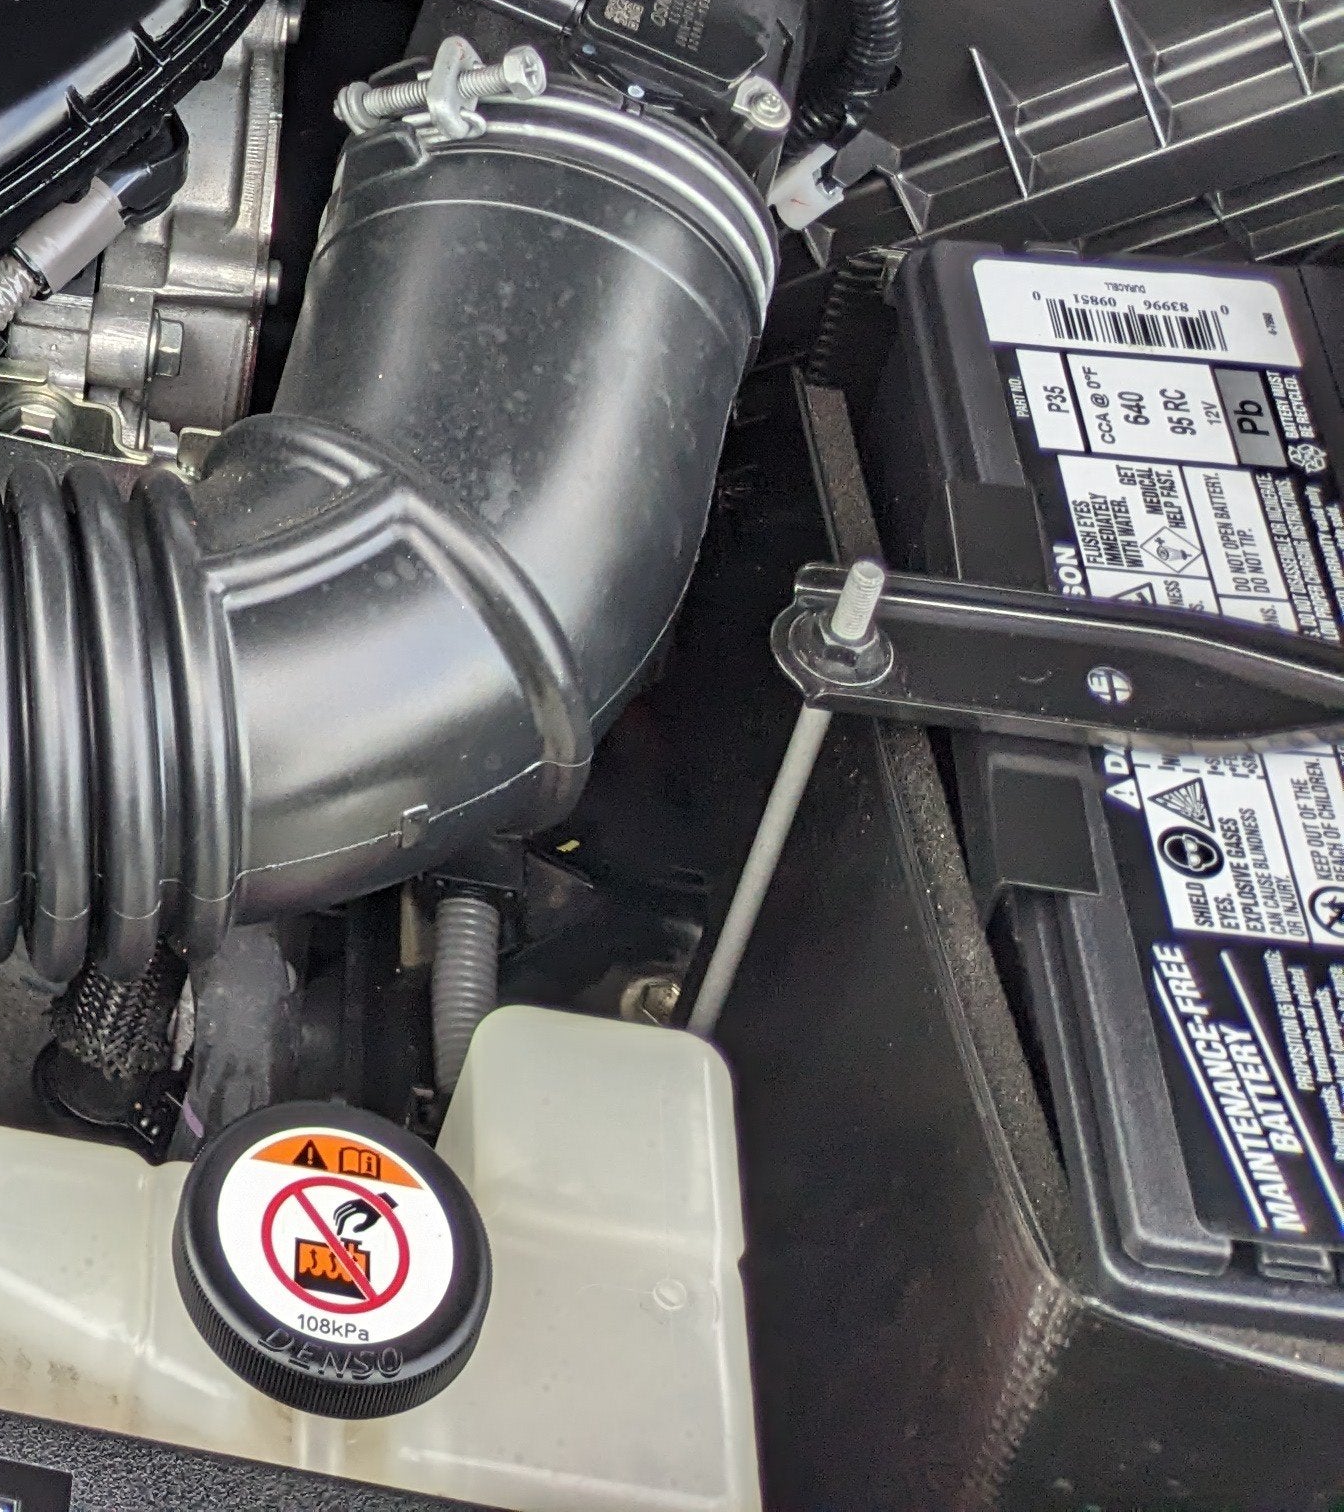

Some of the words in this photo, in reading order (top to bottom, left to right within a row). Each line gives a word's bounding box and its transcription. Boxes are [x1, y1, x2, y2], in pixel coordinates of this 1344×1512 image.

[1104, 282, 1146, 293] DURACELL
[1032, 291, 1041, 301] 0
[1072, 294, 1116, 307] 09851
[1143, 300, 1188, 312] 83996
[1220, 305, 1229, 315] 0
[1009, 376, 1022, 391] NO.
[1266, 370, 1284, 397] MUST
[1012, 394, 1029, 417] PART
[1043, 386, 1069, 413] P35
[1090, 393, 1109, 408] @
[1118, 391, 1150, 425] 640
[1159, 389, 1190, 412] RC
[1201, 401, 1221, 425] 12V
[1284, 375, 1310, 424] RECYCLED.
[1095, 413, 1116, 444] CCA
[1167, 416, 1196, 435] 95
[1234, 400, 1269, 436] Pb
[1275, 400, 1298, 438] BATTERY
[1300, 425, 1315, 438] BE
[1116, 464, 1137, 486] GET
[1155, 470, 1178, 499] FAST.
[1136, 467, 1164, 515] MEDICAL
[1203, 473, 1230, 519] BATTERY.
[1072, 500, 1094, 528] EYES
[1110, 497, 1135, 536] WATER.
[1163, 501, 1186, 529] HELP
[1089, 492, 1124, 566] IMMEDIATELY
[1217, 522, 1239, 550] OPEN
[1236, 528, 1256, 547] TIP.
[1078, 531, 1104, 564] FLUSH
[1121, 540, 1144, 567] WITH
[1053, 545, 1086, 596] SON
[1225, 552, 1246, 574] NOT
[1242, 552, 1264, 574] NOT
[1233, 577, 1251, 592] DO
[1253, 578, 1270, 592] DO
[1291, 778, 1310, 802] THE
[1305, 758, 1334, 820] CHILDREN.
[1297, 803, 1316, 818] OF
[1218, 817, 1244, 858] GASES
[1239, 808, 1270, 868] BLINDNESS
[1302, 822, 1324, 847] OUT
[1321, 824, 1342, 839] OF
[1311, 850, 1334, 882] KEEP
[1185, 882, 1214, 927] SHIELD
[1229, 862, 1266, 933] EXPLOSIVE
[1254, 872, 1279, 909] CAUSE
[1274, 875, 1301, 918] INJURY.
[1214, 894, 1240, 930] EYES.
[1264, 912, 1287, 934] CAN
[1286, 920, 1305, 937] OR
[1264, 949, 1291, 1002] WARNING:
[1288, 966, 1312, 1006] related
[1277, 1004, 1295, 1018] 65
[1299, 1008, 1321, 1030] and
[1282, 1019, 1315, 1091] PROPOSITION
[1303, 1031, 1332, 1082] terminals
[1152, 944, 1308, 1232] MAINTENANCE-FREE
[1219, 1022, 1303, 1153] BATTERY
[296, 1314, 370, 1342] 108kPa
[257, 1328, 405, 1379] DENSO
